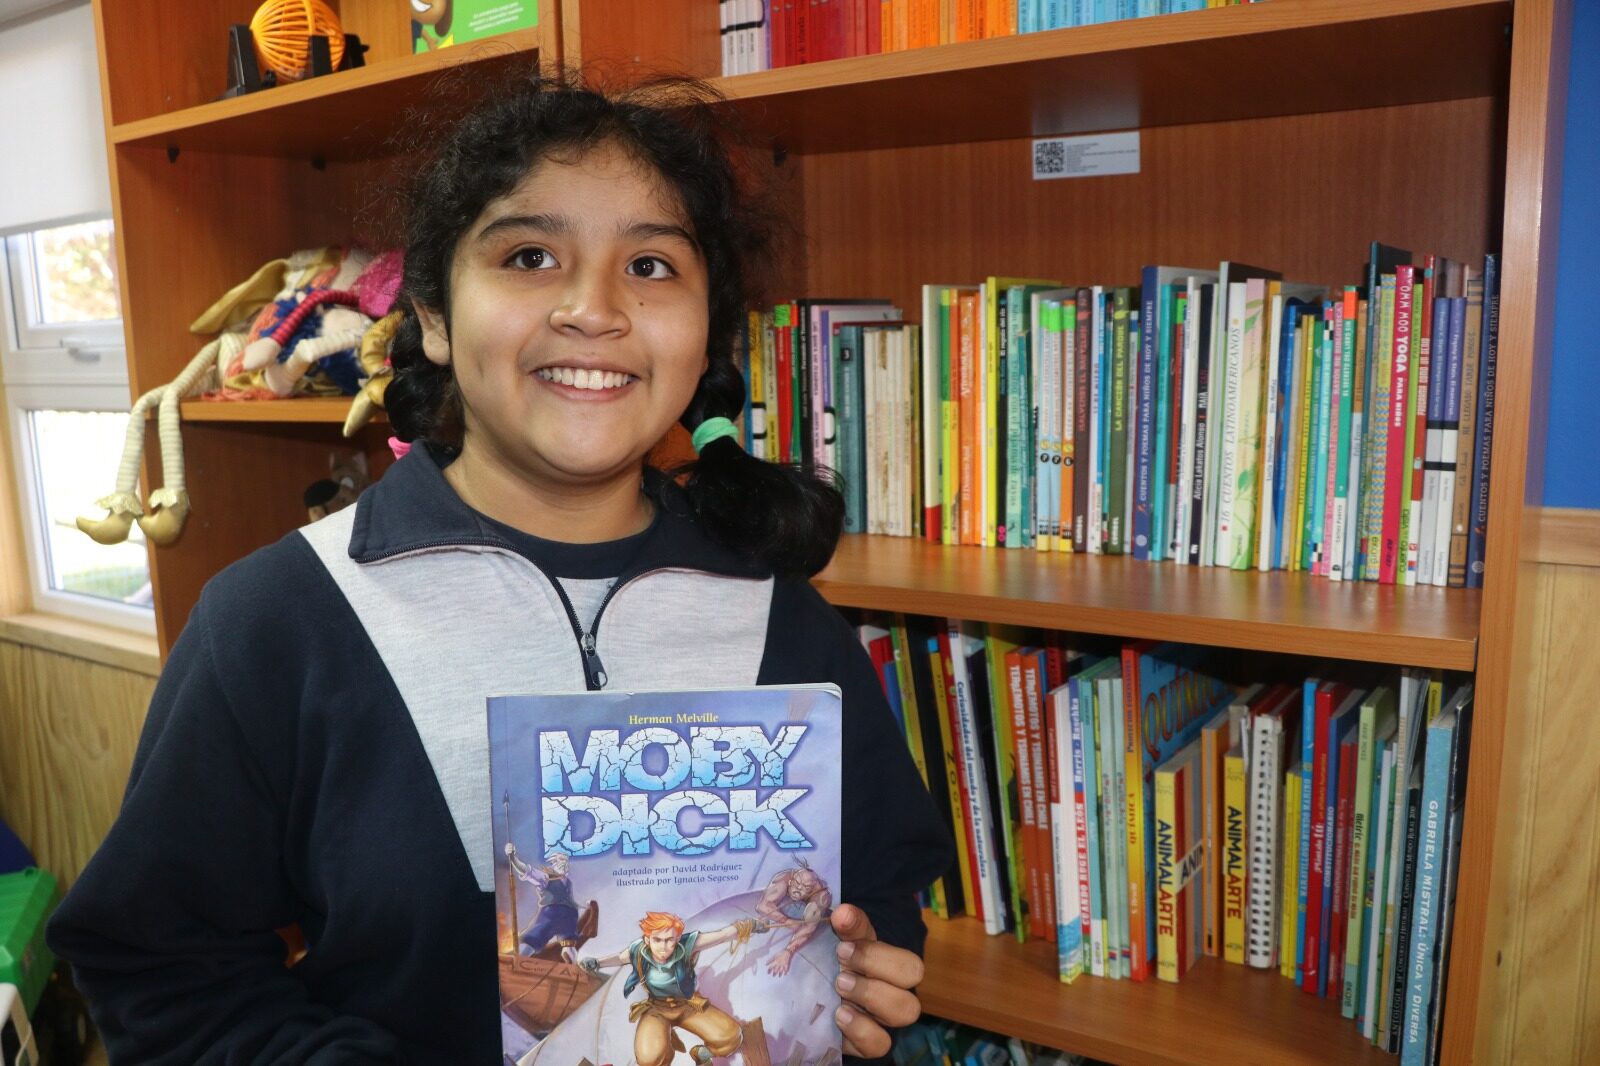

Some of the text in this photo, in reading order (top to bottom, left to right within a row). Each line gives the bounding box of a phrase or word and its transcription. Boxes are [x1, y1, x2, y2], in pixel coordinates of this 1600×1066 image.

[1144, 300, 1152, 333] SIEMPRE
[1488, 294, 1498, 331] SIEMPRE
[1143, 343, 1151, 360] HOY
[1143, 362, 1150, 372] DE
[1393, 285, 1410, 427] OMM MOO YOGA PARA NIÑOS
[1486, 342, 1495, 361] HOY
[1114, 324, 1124, 431] LA CANCIÓN DEL PARQUE
[1141, 375, 1150, 399] NIÑOS
[1486, 365, 1494, 376] DE
[1480, 378, 1493, 407] NIÑOS
[1221, 327, 1242, 522] 16 CUENTOS LATINOAMERICANOS
[1482, 409, 1492, 432] PARA
[1141, 423, 1149, 455] POEMAS
[1480, 435, 1490, 470] POEMAS
[1193, 422, 1205, 499] Alicia Lakatos Alonso
[1139, 464, 1148, 501] CUENTOS
[1477, 481, 1488, 521] CUENTOS
[1398, 508, 1409, 573] cuento vista
[629, 711, 720, 726] Herman Melville
[955, 681, 972, 744] Curiosidades
[964, 745, 973, 761] del
[1070, 697, 1082, 782] Harris Raschka
[539, 725, 809, 794] MOBY
[1016, 738, 1030, 784] TSUNAMIS
[1031, 741, 1044, 786] TSUNAMIS
[945, 749, 963, 818] ZOOM
[966, 762, 977, 795] mundo
[1021, 786, 1031, 798] EN
[1035, 789, 1046, 801] EN
[540, 788, 814, 859] DICK
[971, 804, 980, 814] de
[973, 817, 981, 826] la
[1022, 799, 1034, 825] CHILE
[1036, 802, 1048, 830] CHILE
[1127, 792, 1136, 844] QUÍMICA
[612, 862, 743, 877] adaptado por David Rodríguez
[974, 827, 988, 878] naturaleza
[1074, 802, 1090, 925] CUANDO RUGE EL LEÓN
[1227, 806, 1242, 919] ANIMALARTE
[616, 873, 740, 888] ilustrado por Ignacio Segesso
[1156, 818, 1174, 936] ANIMALARTE
[1408, 799, 1439, 1043] GABRIELA MISTRAL: ÚNICA Y DIVERSA
